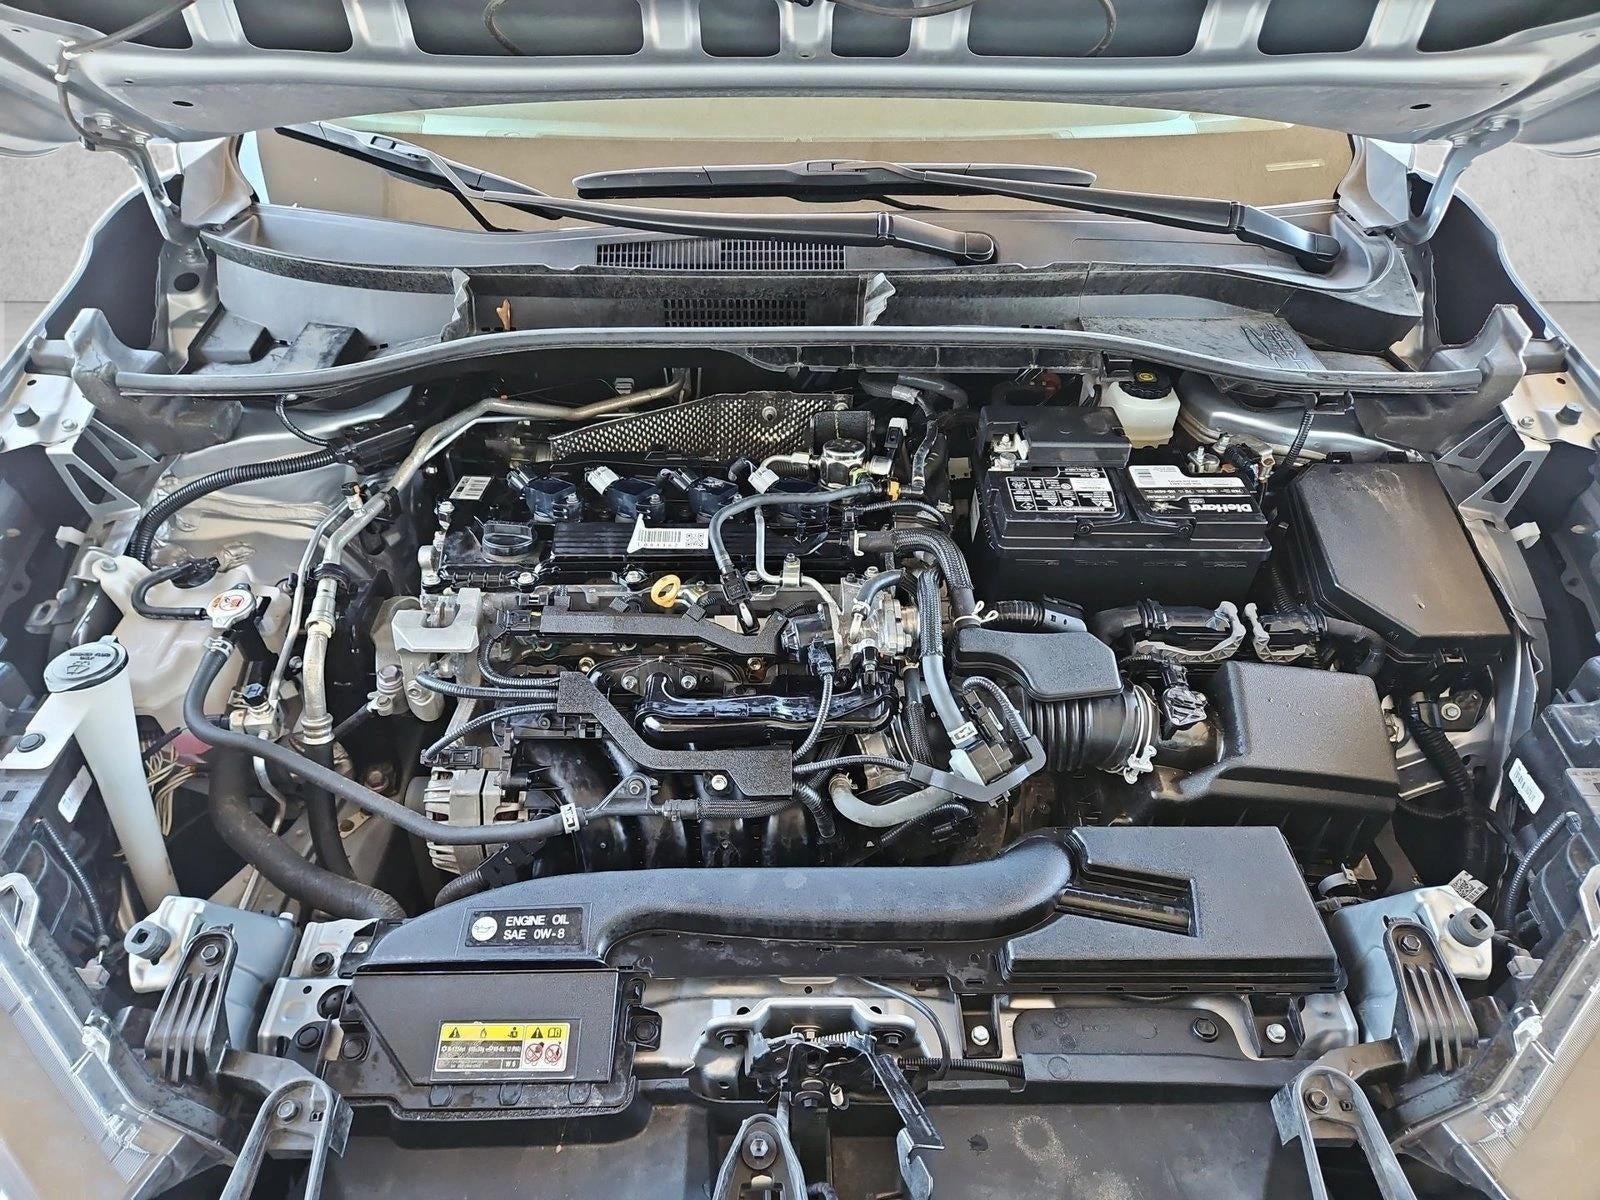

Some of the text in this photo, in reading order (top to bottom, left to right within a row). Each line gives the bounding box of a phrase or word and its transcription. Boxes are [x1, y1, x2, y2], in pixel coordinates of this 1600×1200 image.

[1189, 503, 1253, 513] DieHard
[505, 914, 570, 926] ENGINE OIL
[503, 928, 565, 940] SAE 0W-8
